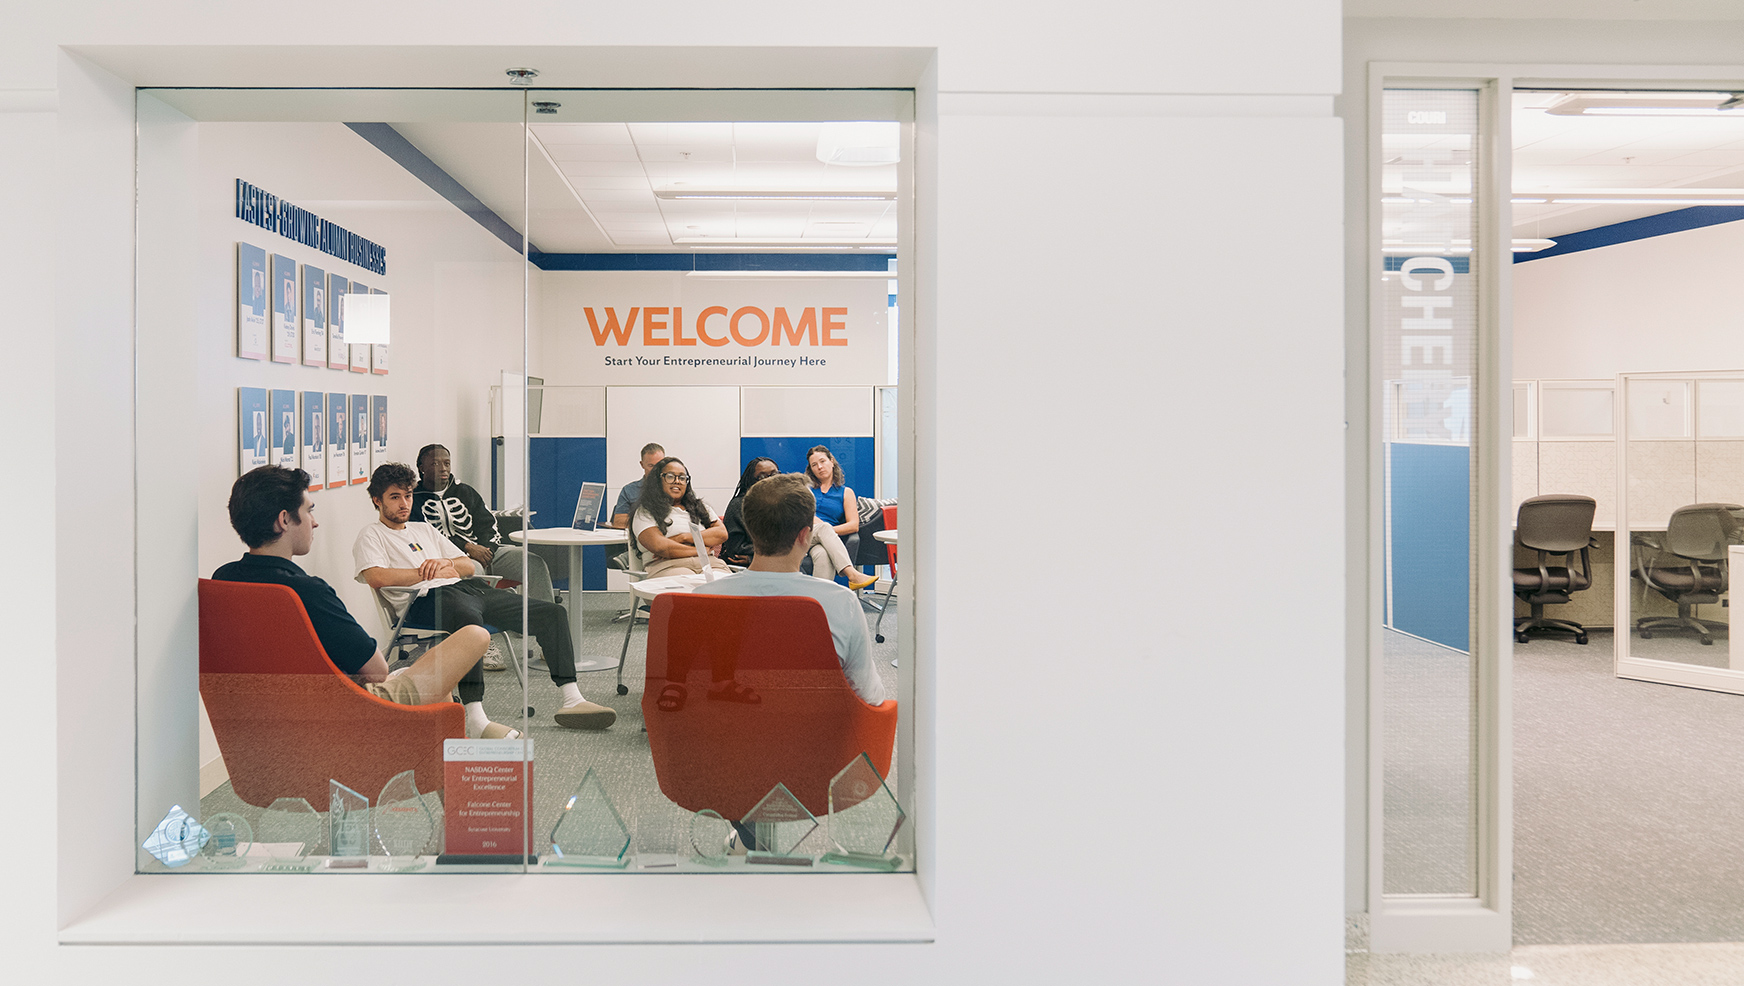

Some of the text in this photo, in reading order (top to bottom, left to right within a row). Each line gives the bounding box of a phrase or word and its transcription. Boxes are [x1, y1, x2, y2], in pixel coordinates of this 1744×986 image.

[1407, 111, 1447, 124] COURI
[348, 231, 386, 276] BUSINESSES
[583, 305, 848, 347] WELCOME
[604, 356, 826, 368] Start Your Entrepreneurial Journey Here
[447, 746, 474, 755] GCEC
[465, 766, 494, 774] NASDAQ
[471, 775, 517, 783] Entrepreneurial
[469, 810, 520, 818] Entrepreneurship
